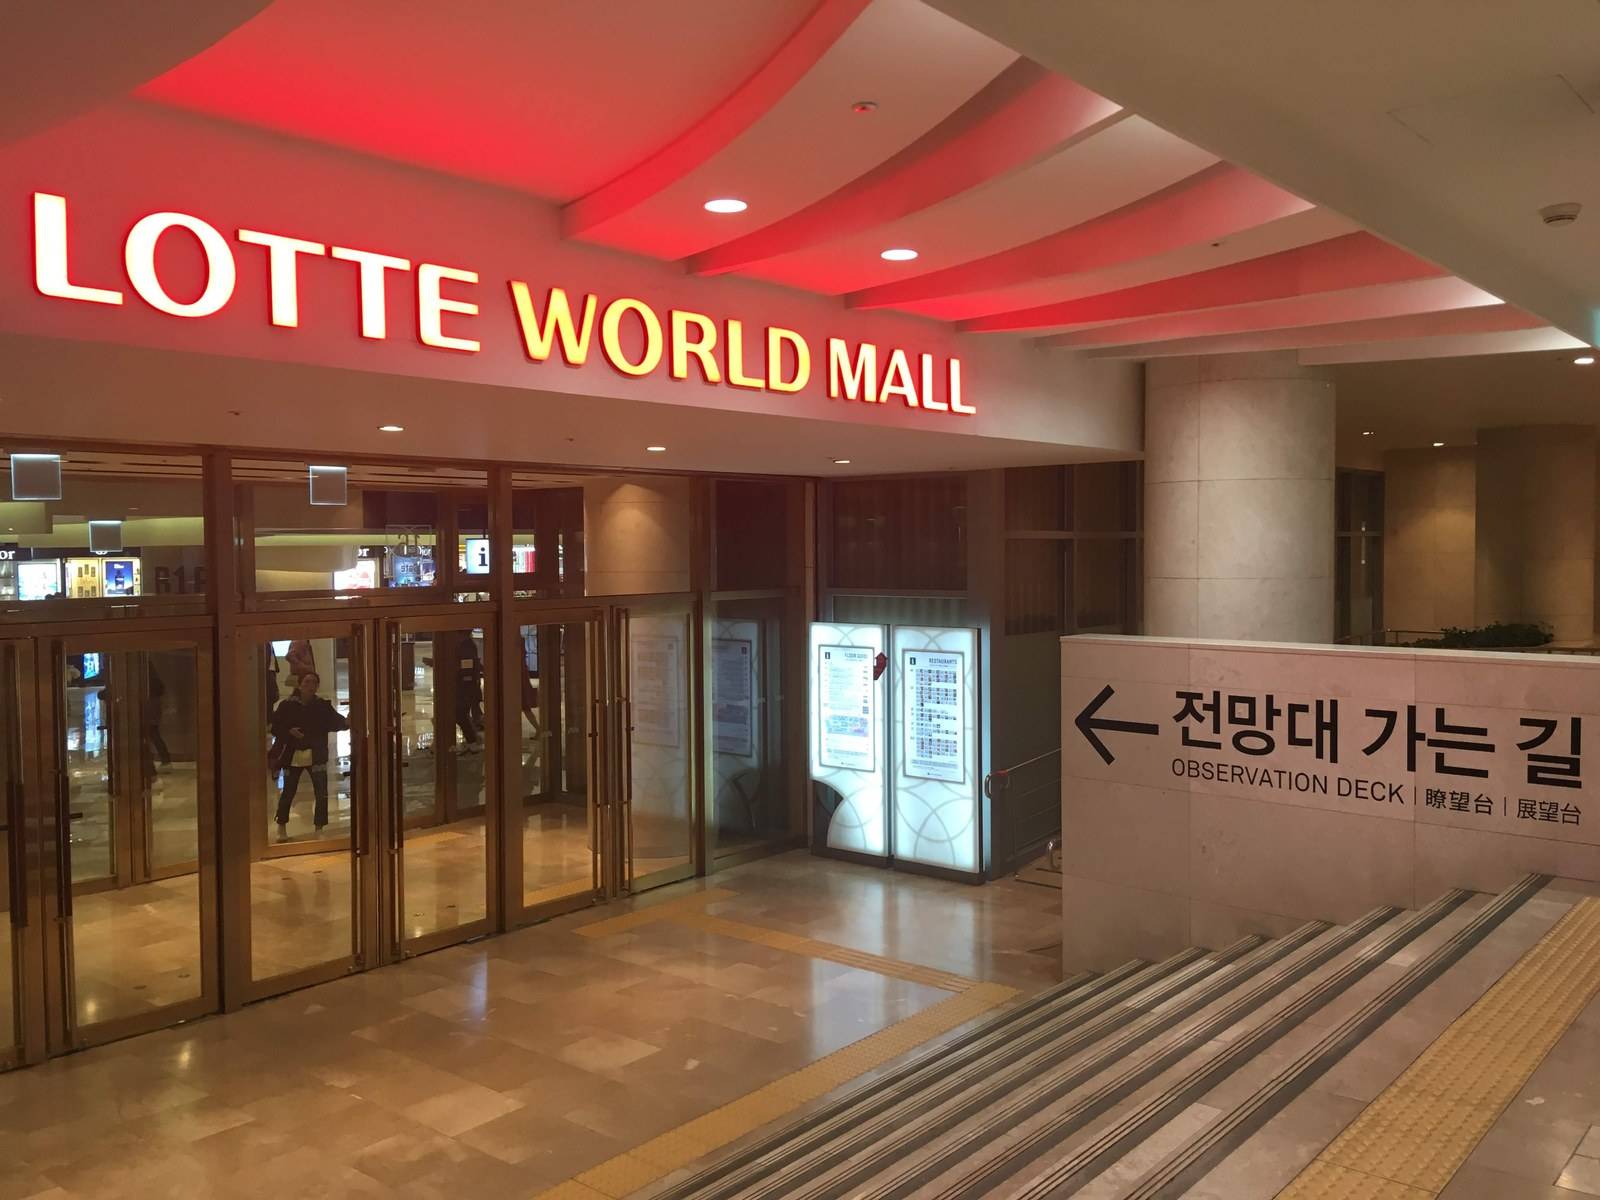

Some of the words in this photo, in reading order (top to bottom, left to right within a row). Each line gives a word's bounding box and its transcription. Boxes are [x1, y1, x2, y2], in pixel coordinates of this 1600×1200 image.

[30, 191, 481, 352] LOTTE
[507, 279, 811, 394] WORLD
[826, 337, 977, 415] MALL
[1172, 690, 1339, 764] 전망대
[1361, 704, 1496, 779] 가는
[1516, 716, 1583, 789] 길
[1171, 758, 1329, 795] OBSERVATION
[1336, 776, 1405, 805] DECK
[1425, 787, 1494, 816] 瞭望台
[1516, 798, 1583, 826] 展望台
